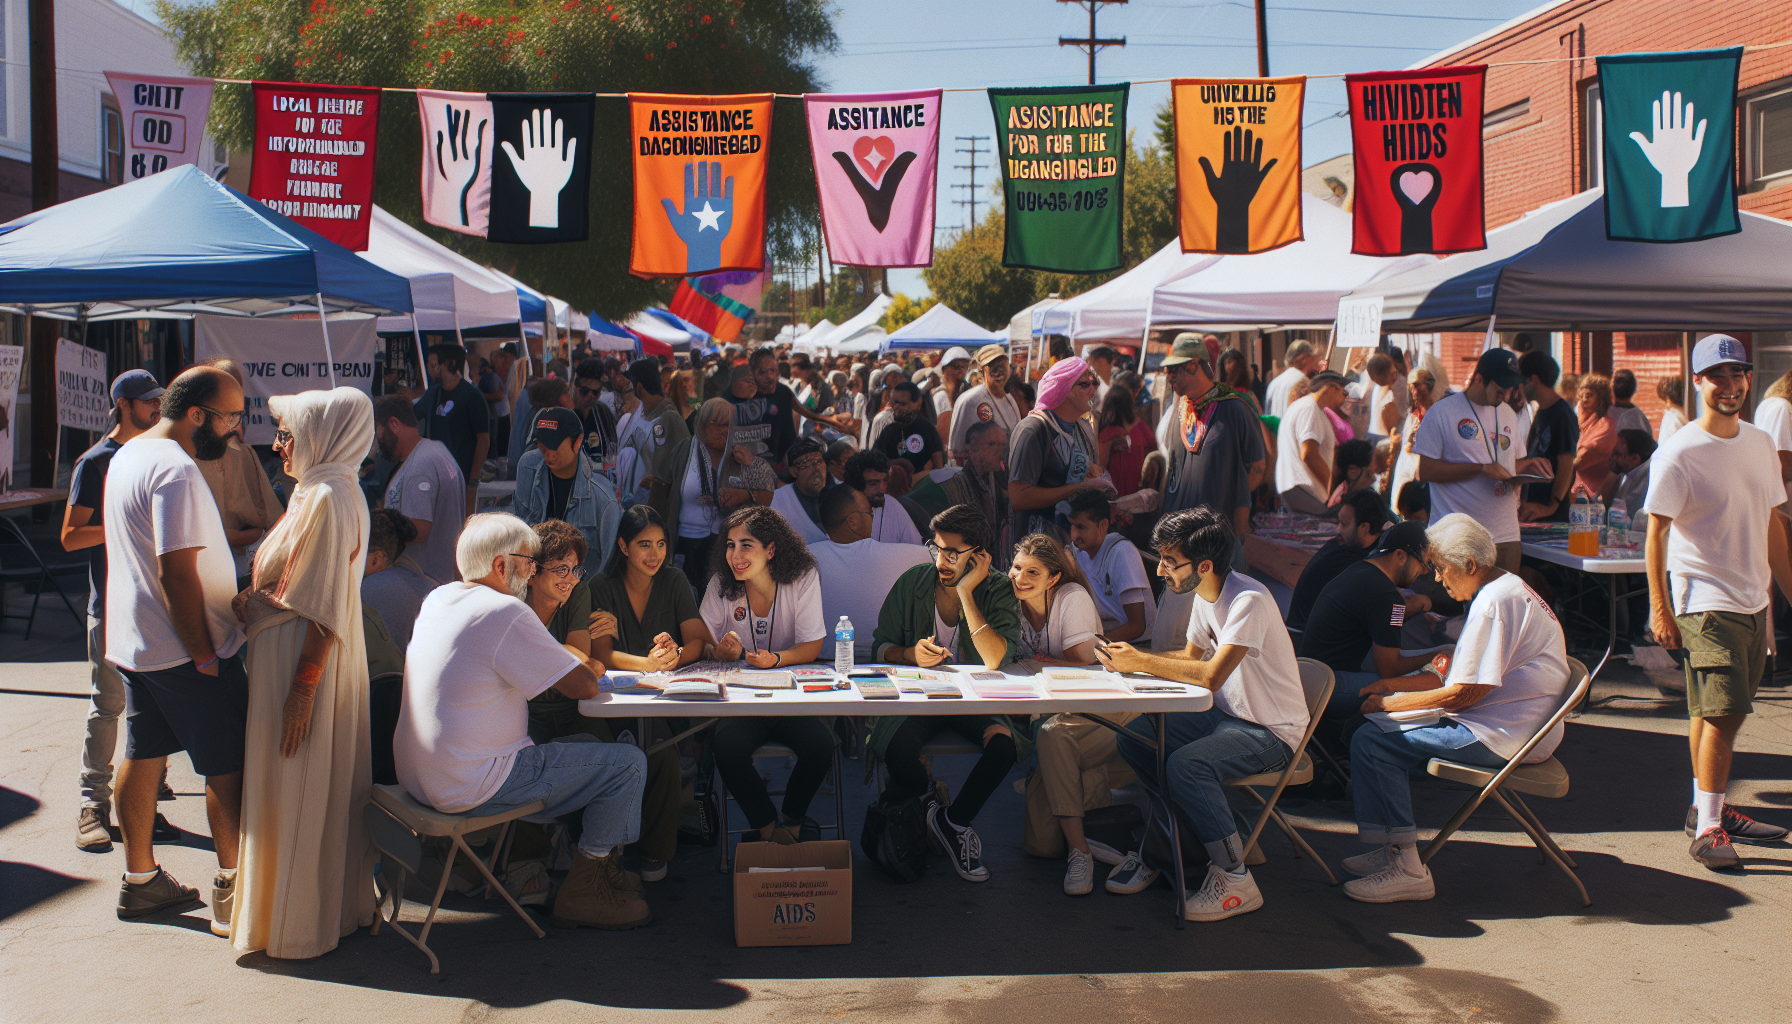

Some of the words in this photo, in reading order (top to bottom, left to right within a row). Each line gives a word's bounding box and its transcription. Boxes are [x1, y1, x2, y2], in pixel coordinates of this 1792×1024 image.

[827, 103, 925, 131] ASSITANCE
[1363, 82, 1462, 121] HIVIDTEN
[1383, 122, 1447, 162] HIIDS
[773, 902, 816, 925] AIDS
